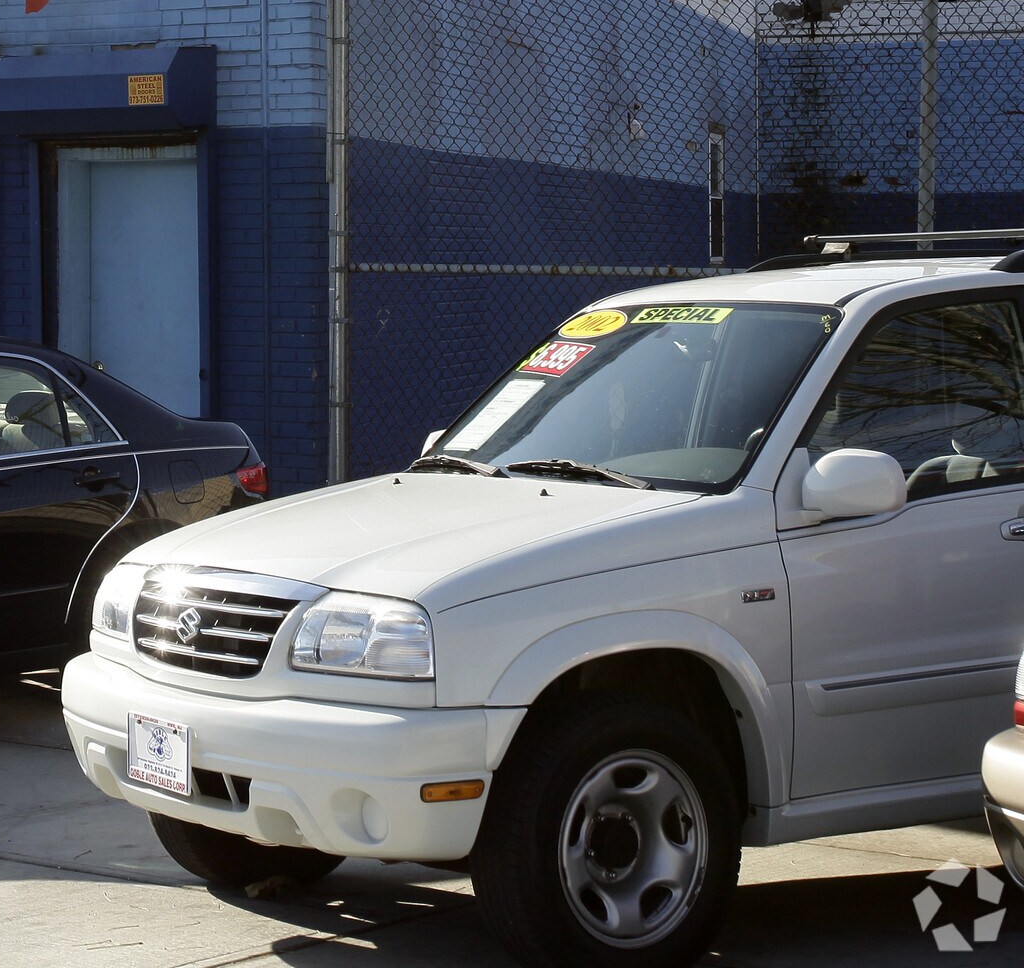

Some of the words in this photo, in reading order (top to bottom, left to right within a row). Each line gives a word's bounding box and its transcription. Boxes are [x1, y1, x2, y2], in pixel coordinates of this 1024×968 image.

[638, 308, 720, 321] SPECIAL
[565, 314, 621, 332] 2002
[158, 776, 172, 789] SALES
